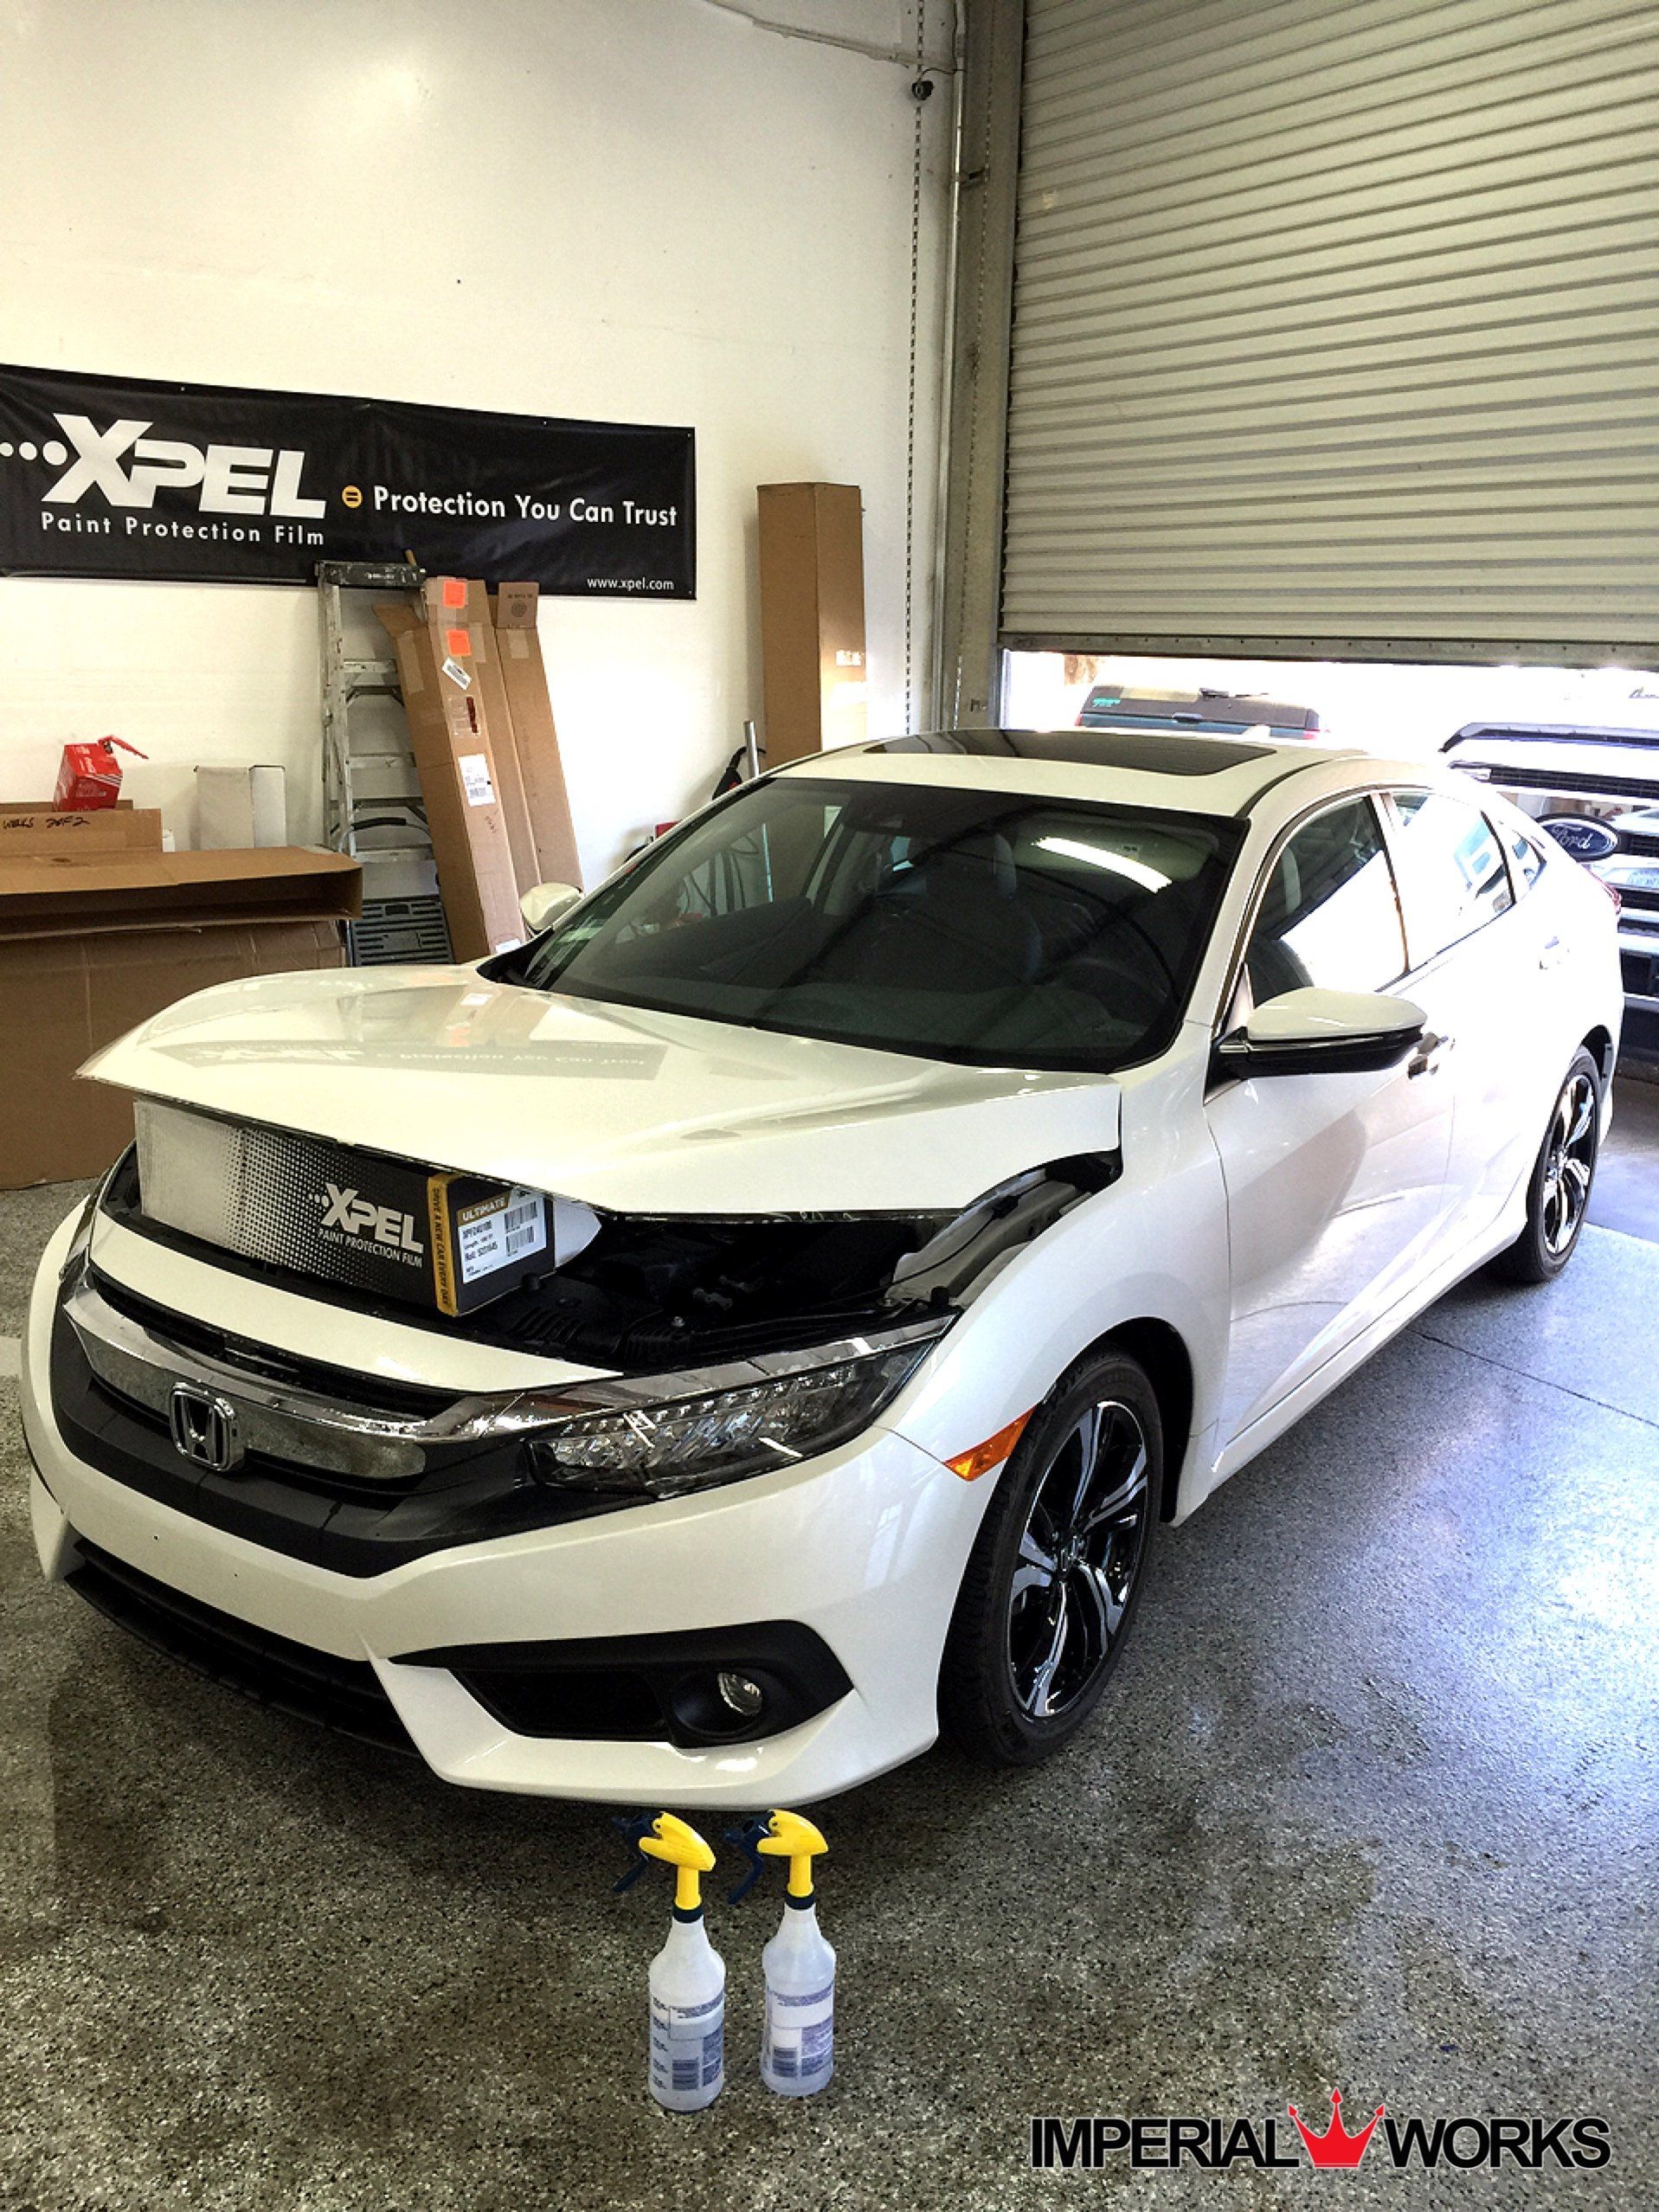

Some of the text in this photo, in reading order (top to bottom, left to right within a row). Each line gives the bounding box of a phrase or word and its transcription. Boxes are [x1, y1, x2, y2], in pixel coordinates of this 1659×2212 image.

[42, 412, 326, 519] XPEL
[374, 485, 677, 526] Protection You Can Trust
[41, 511, 325, 545] Paint Protection Film
[587, 576, 674, 592] www.xpel.com
[1552, 823, 1593, 850] Ford
[321, 1182, 424, 1254] XPEL
[318, 1228, 422, 1269] PAINT PROTECTION FILM
